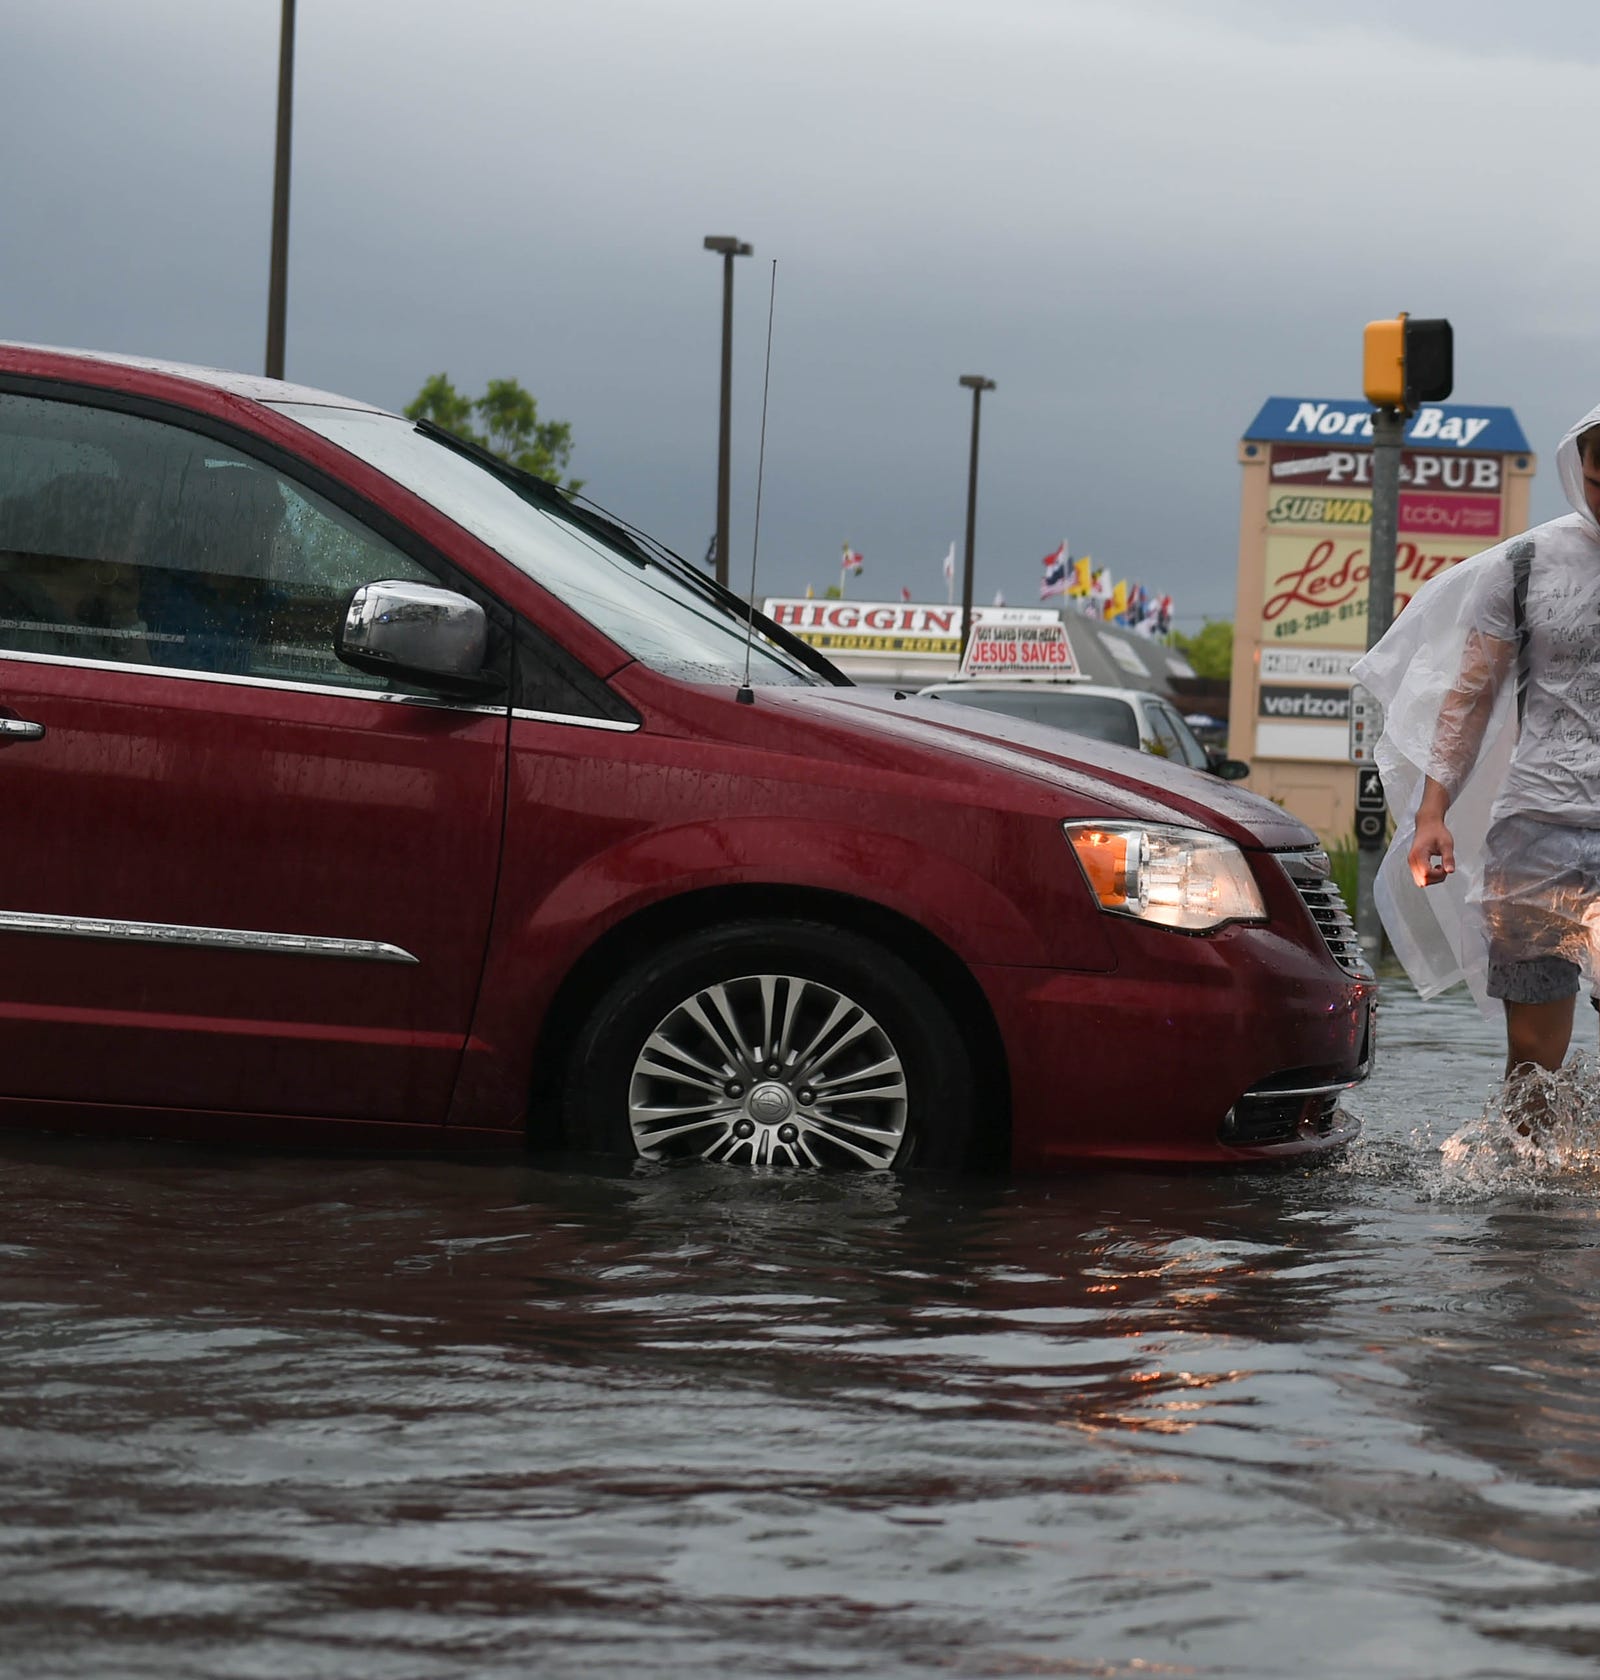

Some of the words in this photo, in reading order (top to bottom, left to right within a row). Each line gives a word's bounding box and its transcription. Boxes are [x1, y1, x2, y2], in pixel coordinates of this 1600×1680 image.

[1410, 408, 1490, 446] Bay
[1327, 452, 1375, 482] PI
[1413, 457, 1499, 488] PUB
[1263, 539, 1371, 620] Ledo
[972, 641, 1017, 663] JESUS
[1021, 641, 1066, 663] SAVES
